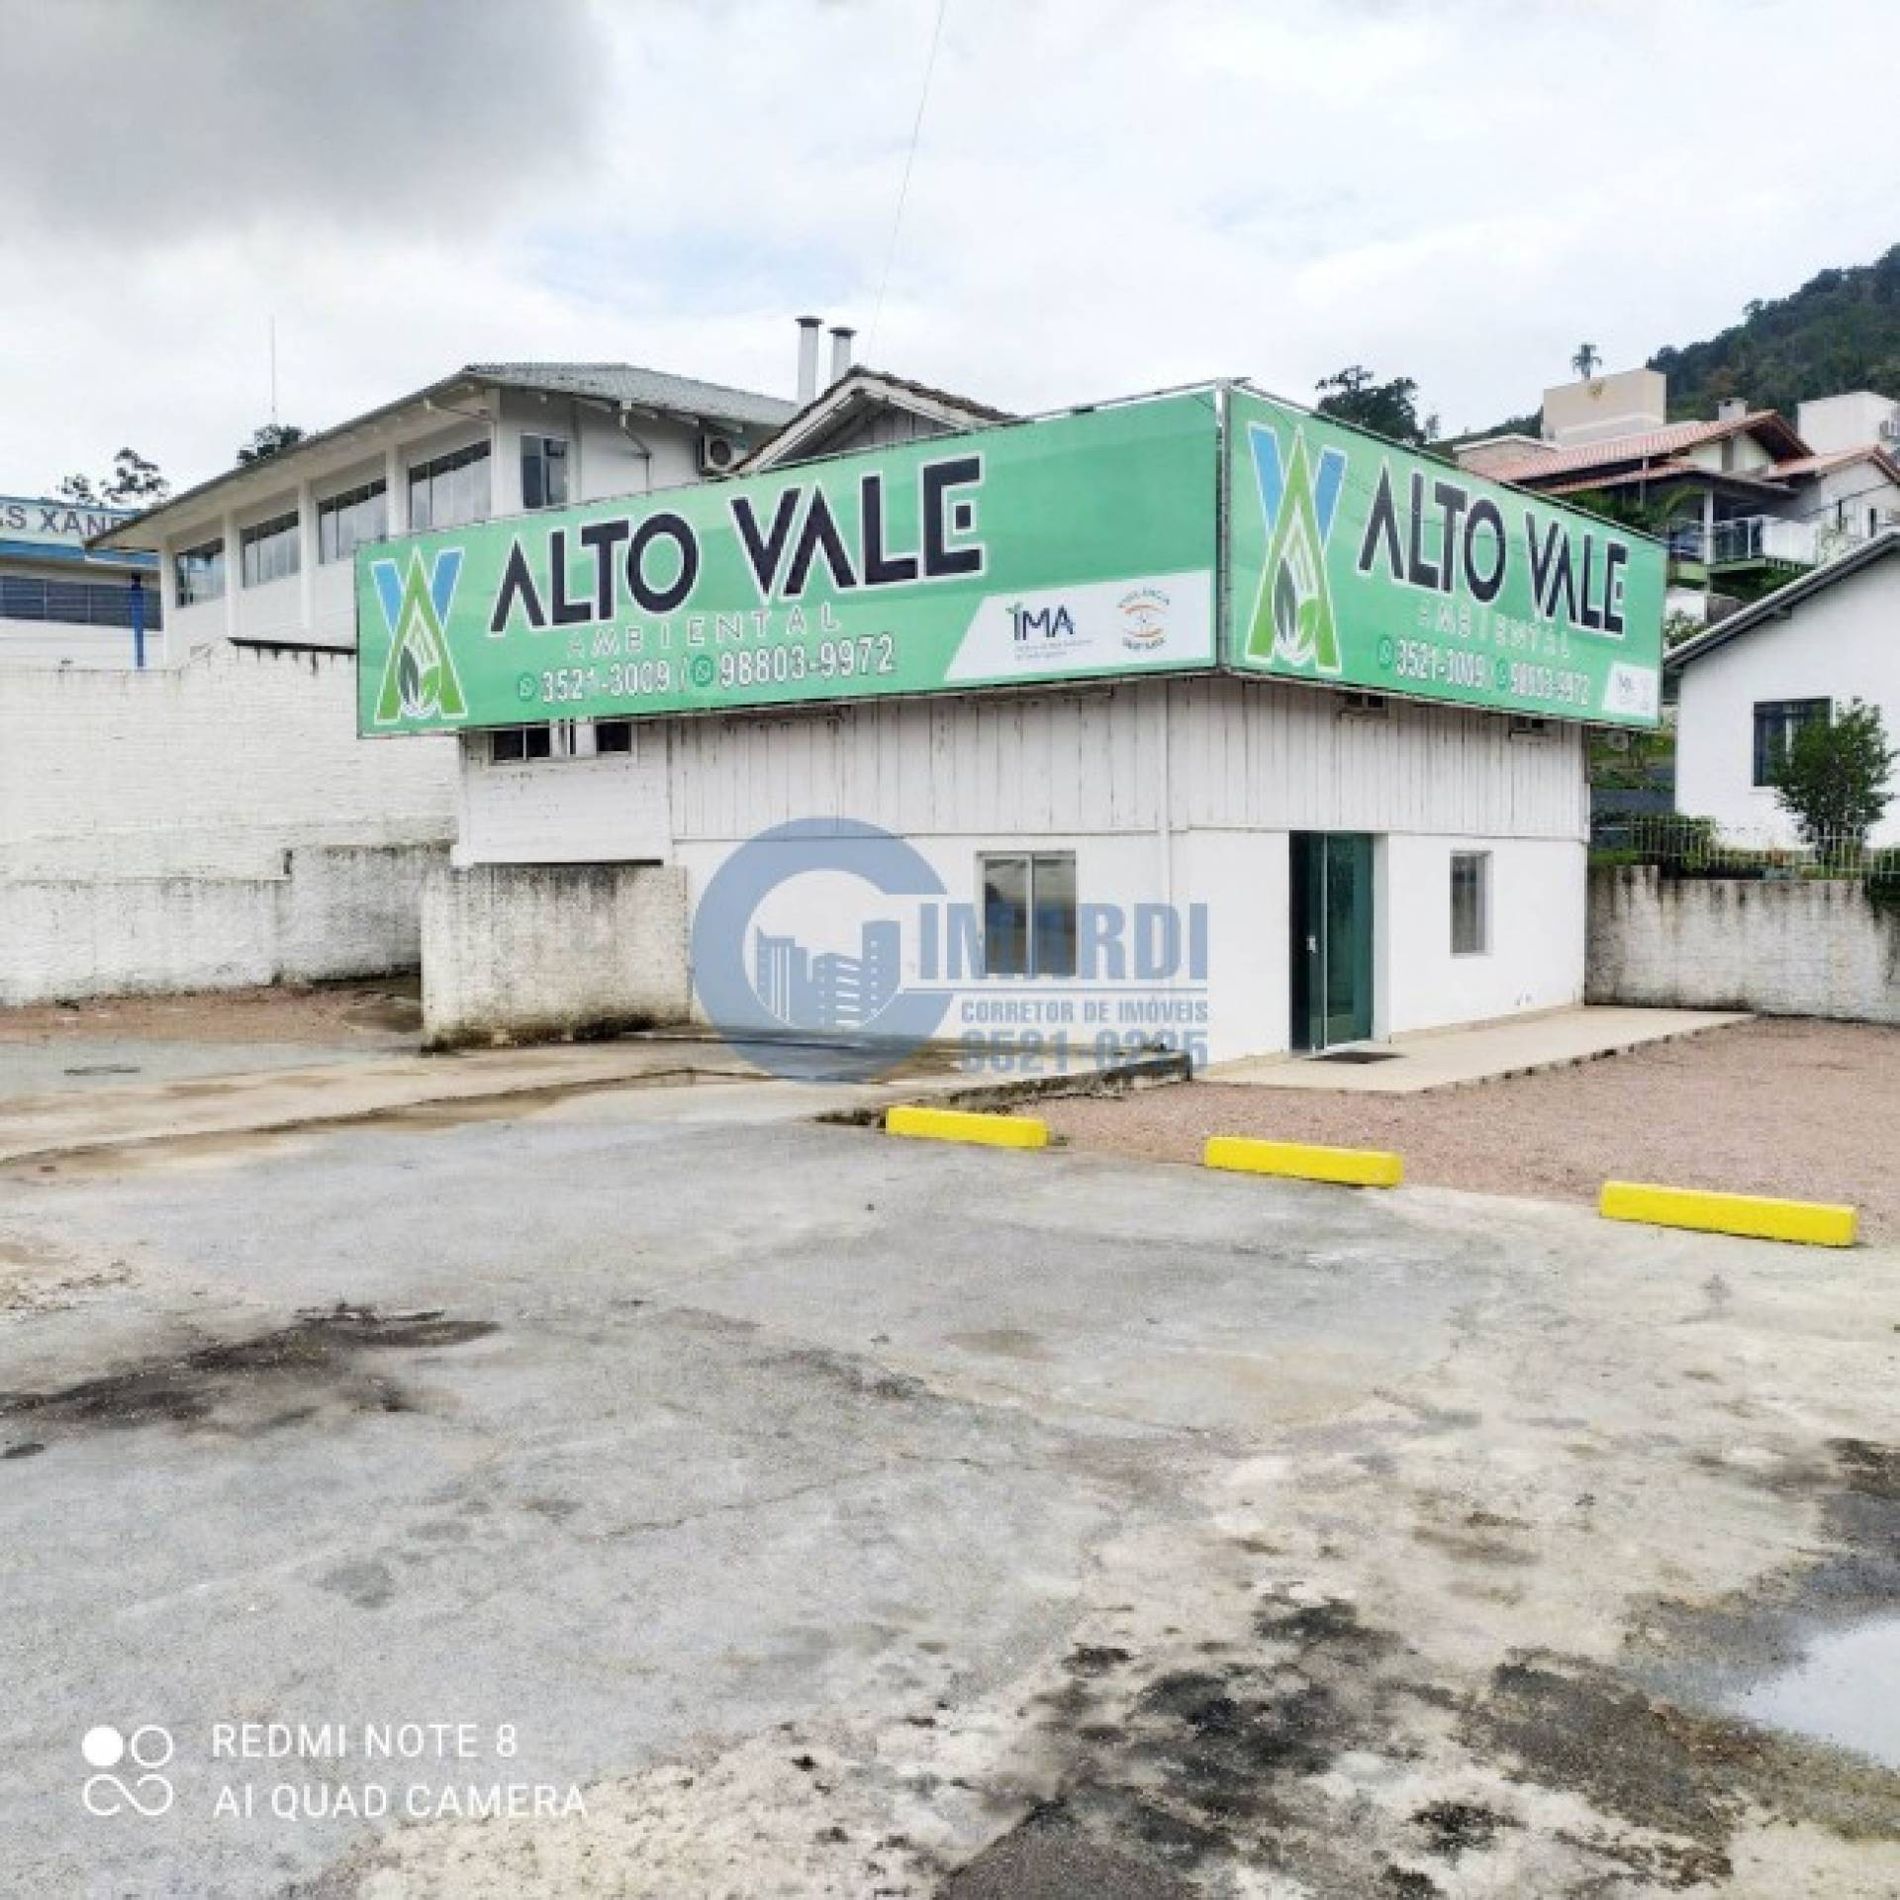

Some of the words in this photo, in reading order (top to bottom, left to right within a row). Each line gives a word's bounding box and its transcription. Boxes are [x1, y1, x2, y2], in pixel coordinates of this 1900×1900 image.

[488, 512, 700, 637] ALTO
[730, 451, 987, 602] VALE
[1356, 457, 1506, 604] ALTO
[1524, 509, 1630, 640] VALE
[719, 632, 896, 689] 98803-9972
